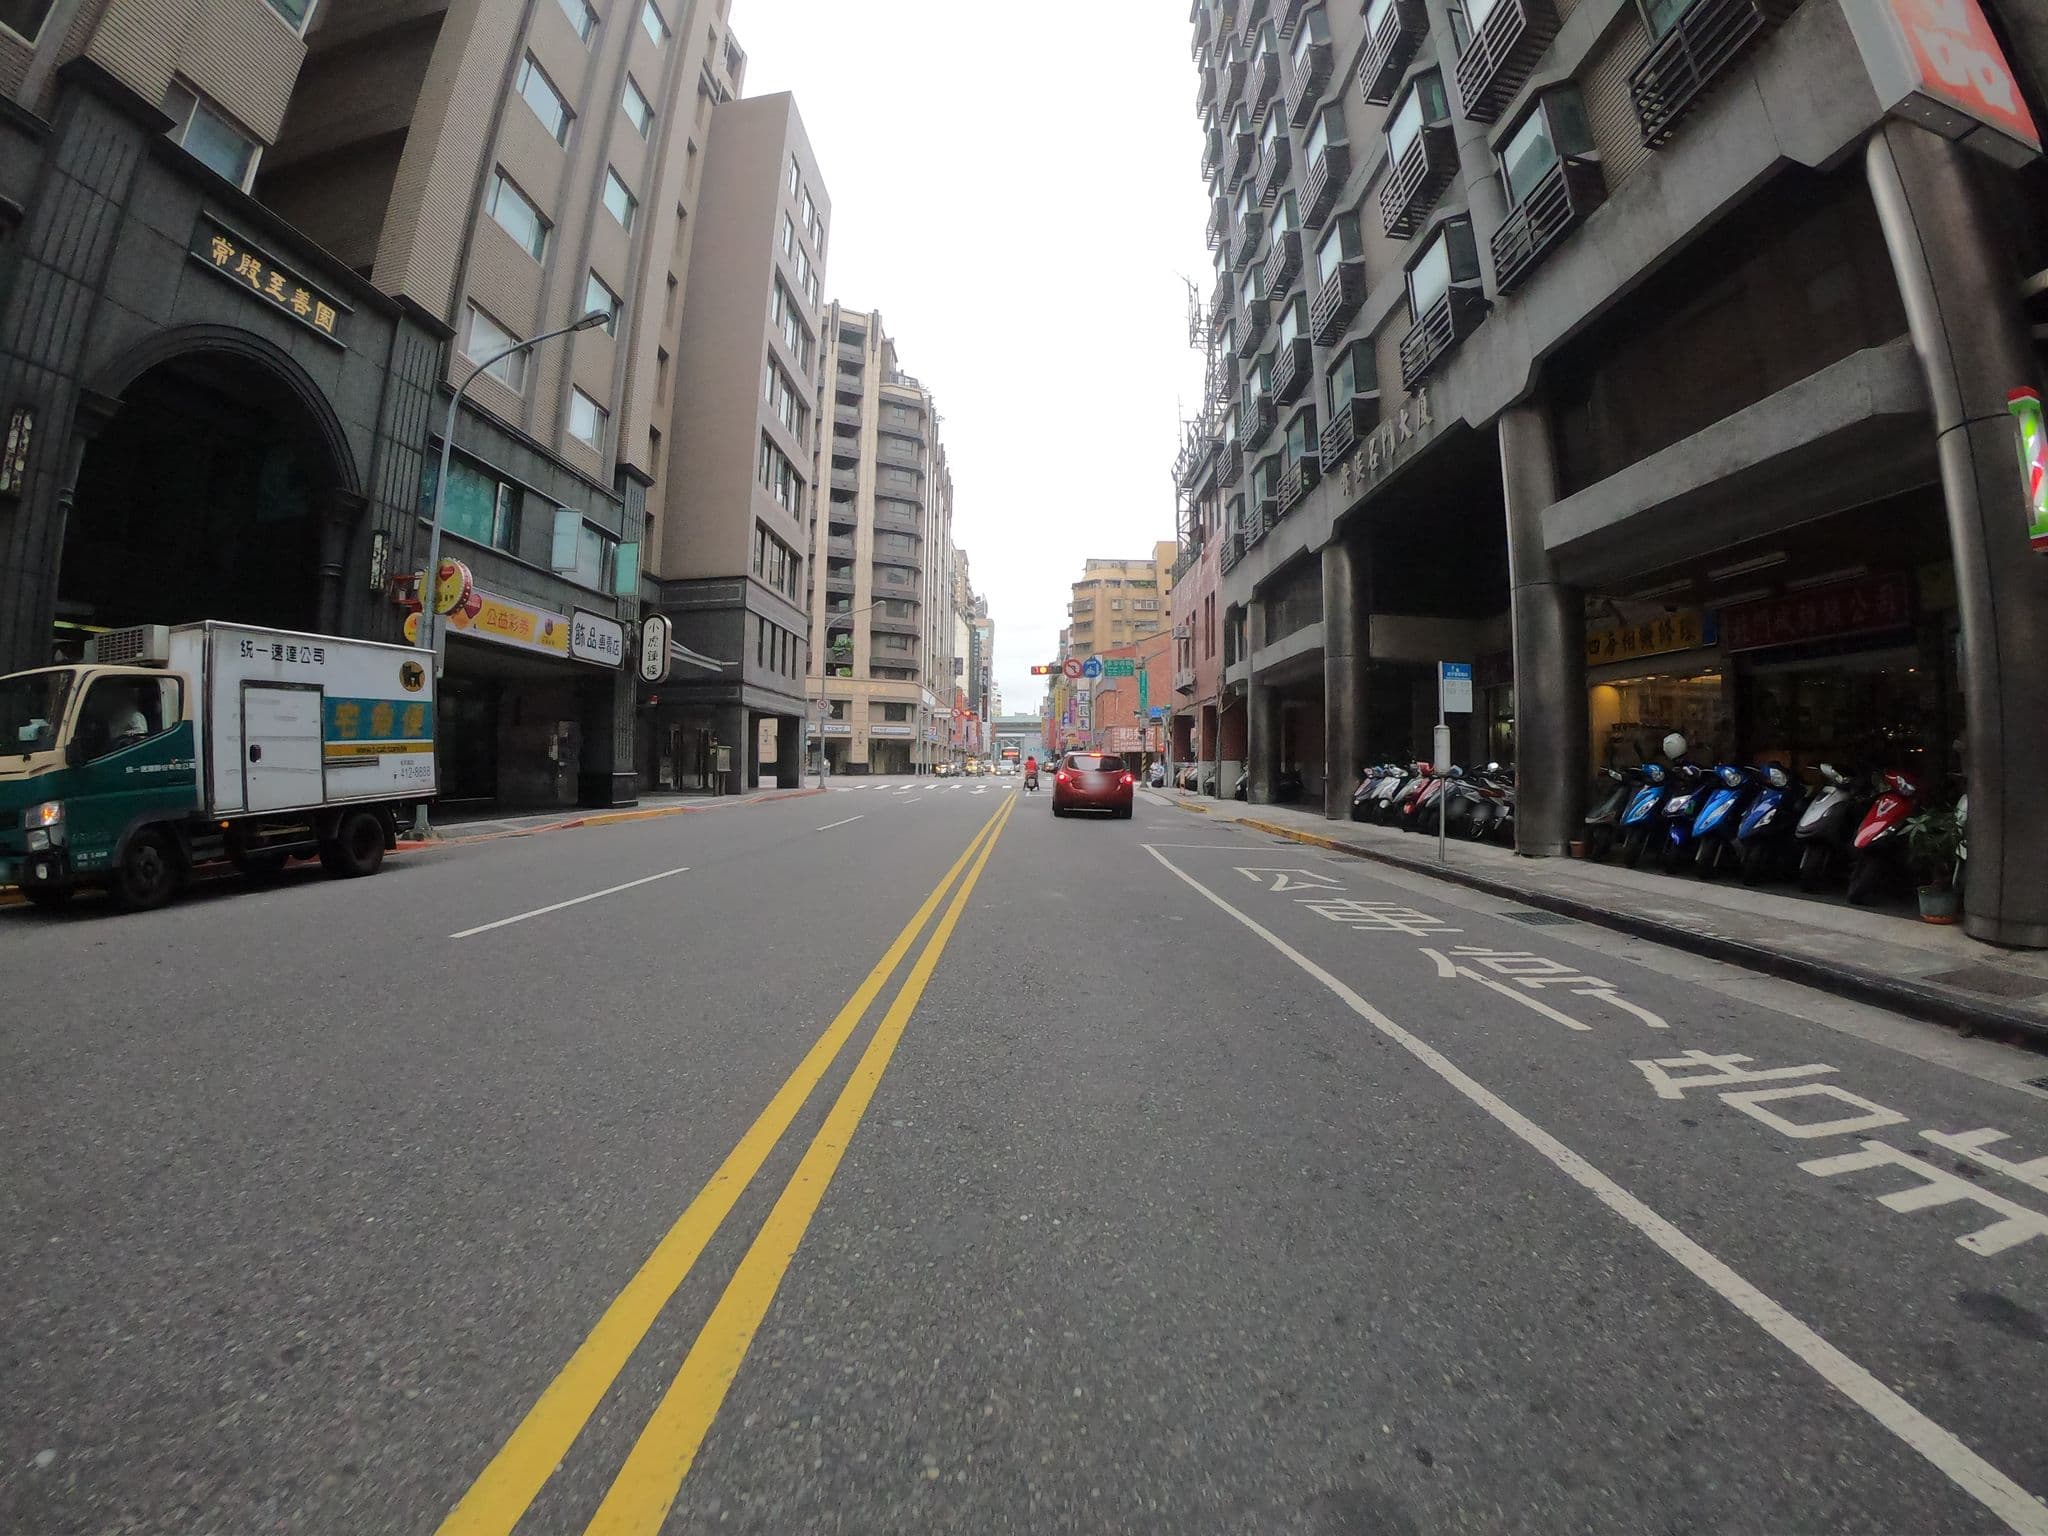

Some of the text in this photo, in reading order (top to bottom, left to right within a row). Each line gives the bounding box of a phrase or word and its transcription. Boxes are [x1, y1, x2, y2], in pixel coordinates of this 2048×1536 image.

[487, 608, 529, 636] 公益彩券
[240, 639, 325, 665] 統一速達公司
[575, 621, 621, 656] 飾品專賣店
